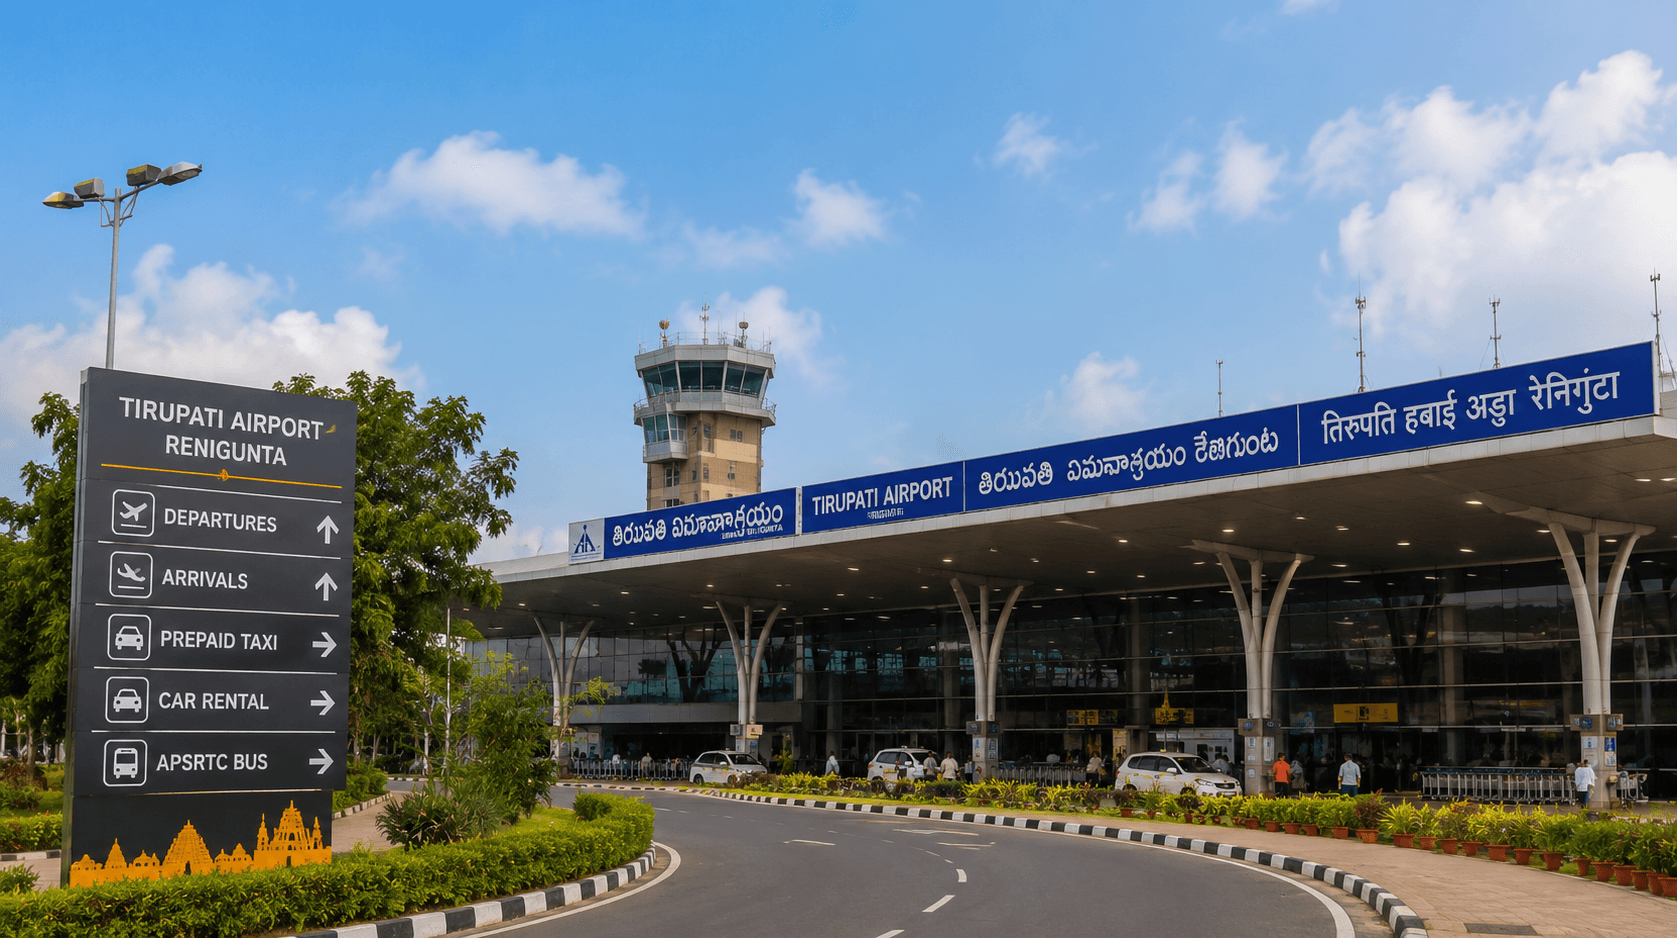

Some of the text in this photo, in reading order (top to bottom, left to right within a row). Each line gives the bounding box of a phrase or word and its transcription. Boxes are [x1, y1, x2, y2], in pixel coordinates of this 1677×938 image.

[118, 396, 324, 440] TIRUPATI AIRPORT
[1320, 401, 1397, 445] तिरुपति
[1528, 367, 1621, 415] रेनिगुंटा
[165, 434, 287, 466] RENIGUNTA
[812, 487, 879, 516] TIRUPATI
[883, 476, 953, 505] AIRPORT
[164, 507, 278, 533] DEPARTURES
[161, 568, 249, 590] ARRIVALS
[160, 630, 278, 651] PREPAID TAXI
[158, 691, 270, 710] CAR RENTAL
[156, 753, 268, 772] APSRTC BUS
